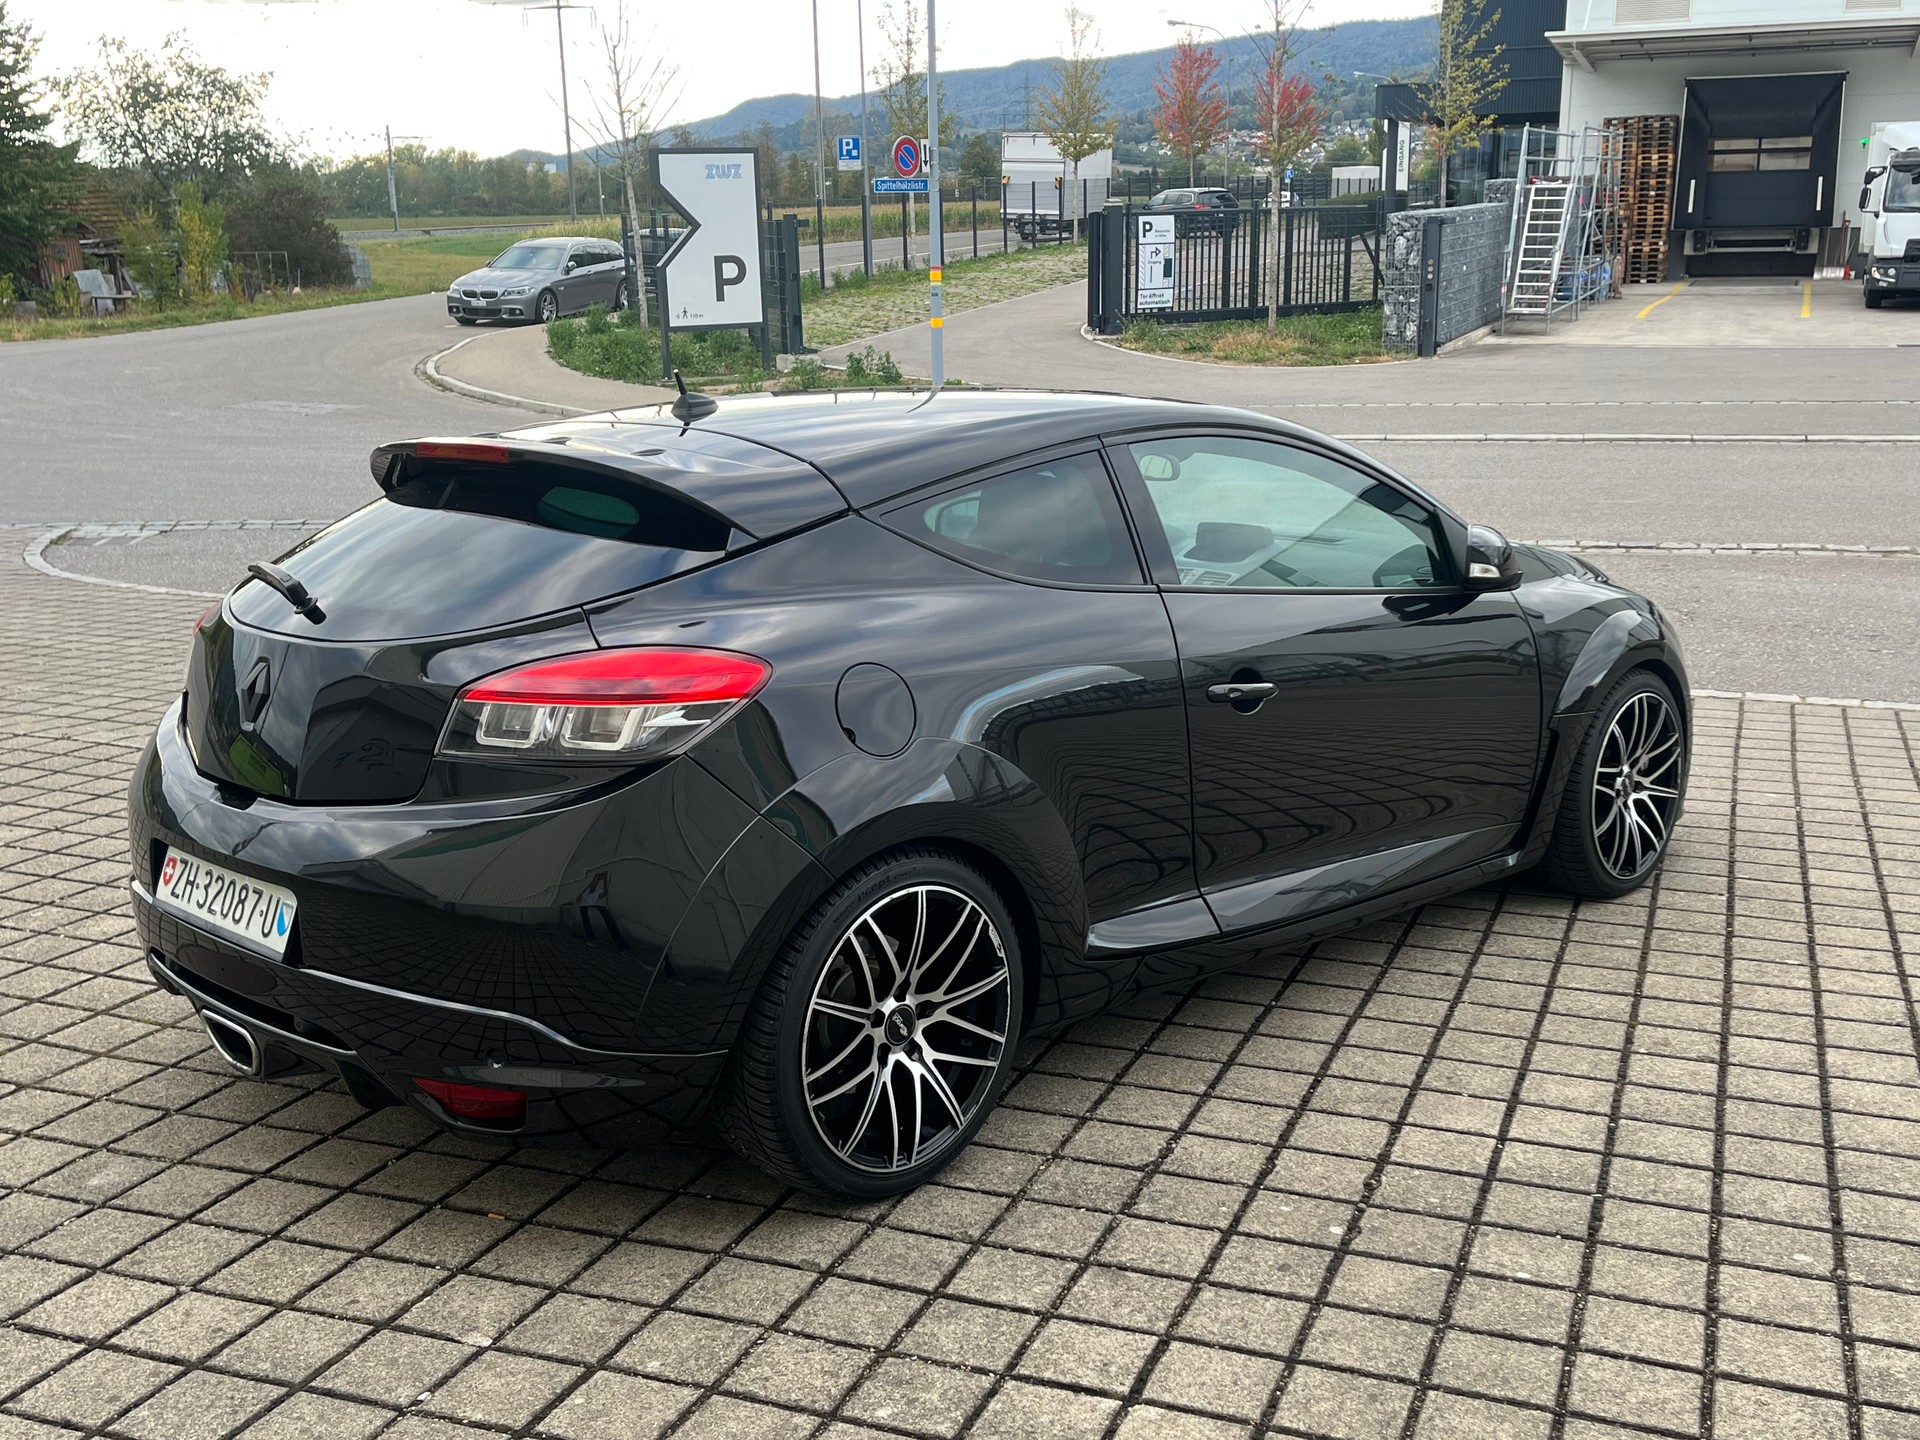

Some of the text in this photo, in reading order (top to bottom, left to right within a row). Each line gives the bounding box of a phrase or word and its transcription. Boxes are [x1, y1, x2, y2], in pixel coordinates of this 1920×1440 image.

[842, 138, 854, 155] P
[1142, 221, 1153, 238] P
[714, 255, 747, 302] P
